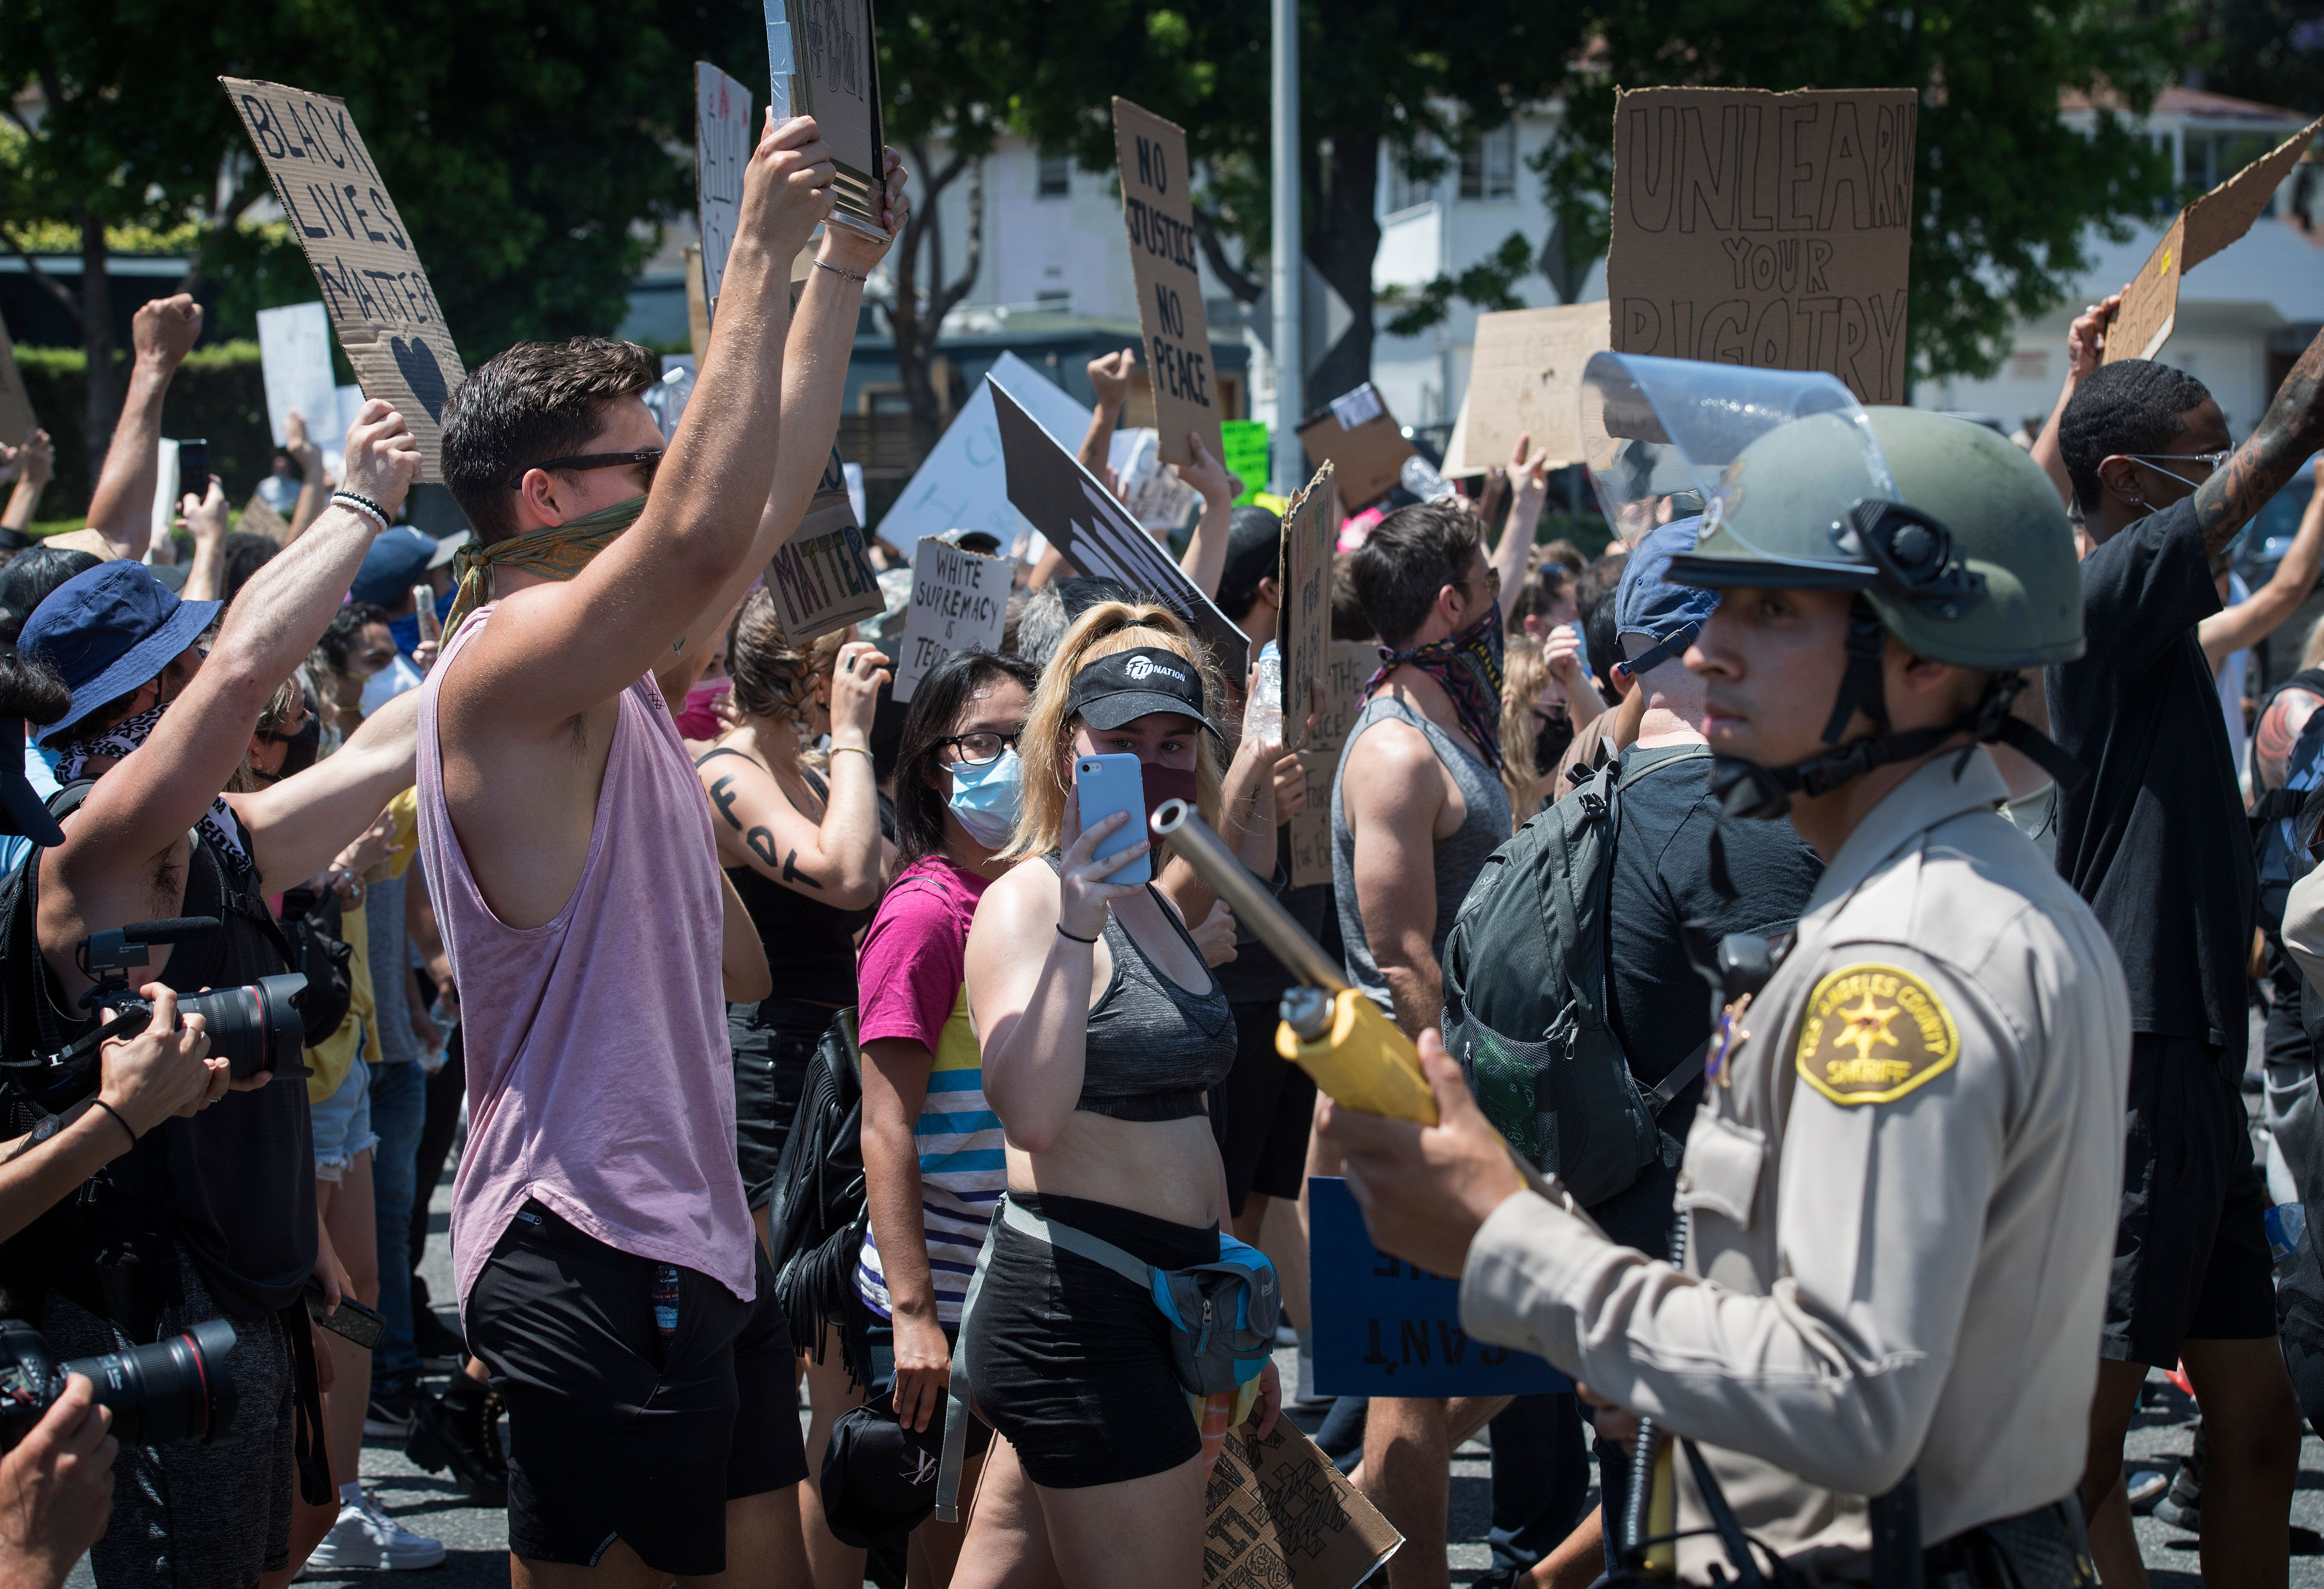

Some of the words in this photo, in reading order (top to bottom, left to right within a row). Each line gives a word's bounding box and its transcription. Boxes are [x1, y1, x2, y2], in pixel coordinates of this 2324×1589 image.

[241, 95, 380, 186] BLACK
[1136, 135, 1166, 195] NO
[1629, 101, 1916, 233] UNLEARN
[276, 173, 408, 251] LIVES
[1127, 196, 1198, 275] JUSTICE
[1721, 236, 1834, 294] YOUR
[1156, 283, 1184, 339] NO
[1153, 336, 1210, 408] PEACE
[772, 524, 880, 625] MATTER
[936, 550, 983, 589] WHITE
[915, 580, 1000, 631] SUPREMACY
[944, 620, 955, 639] IS
[1153, 664, 1186, 682] NATION
[710, 773, 824, 890] FDT
